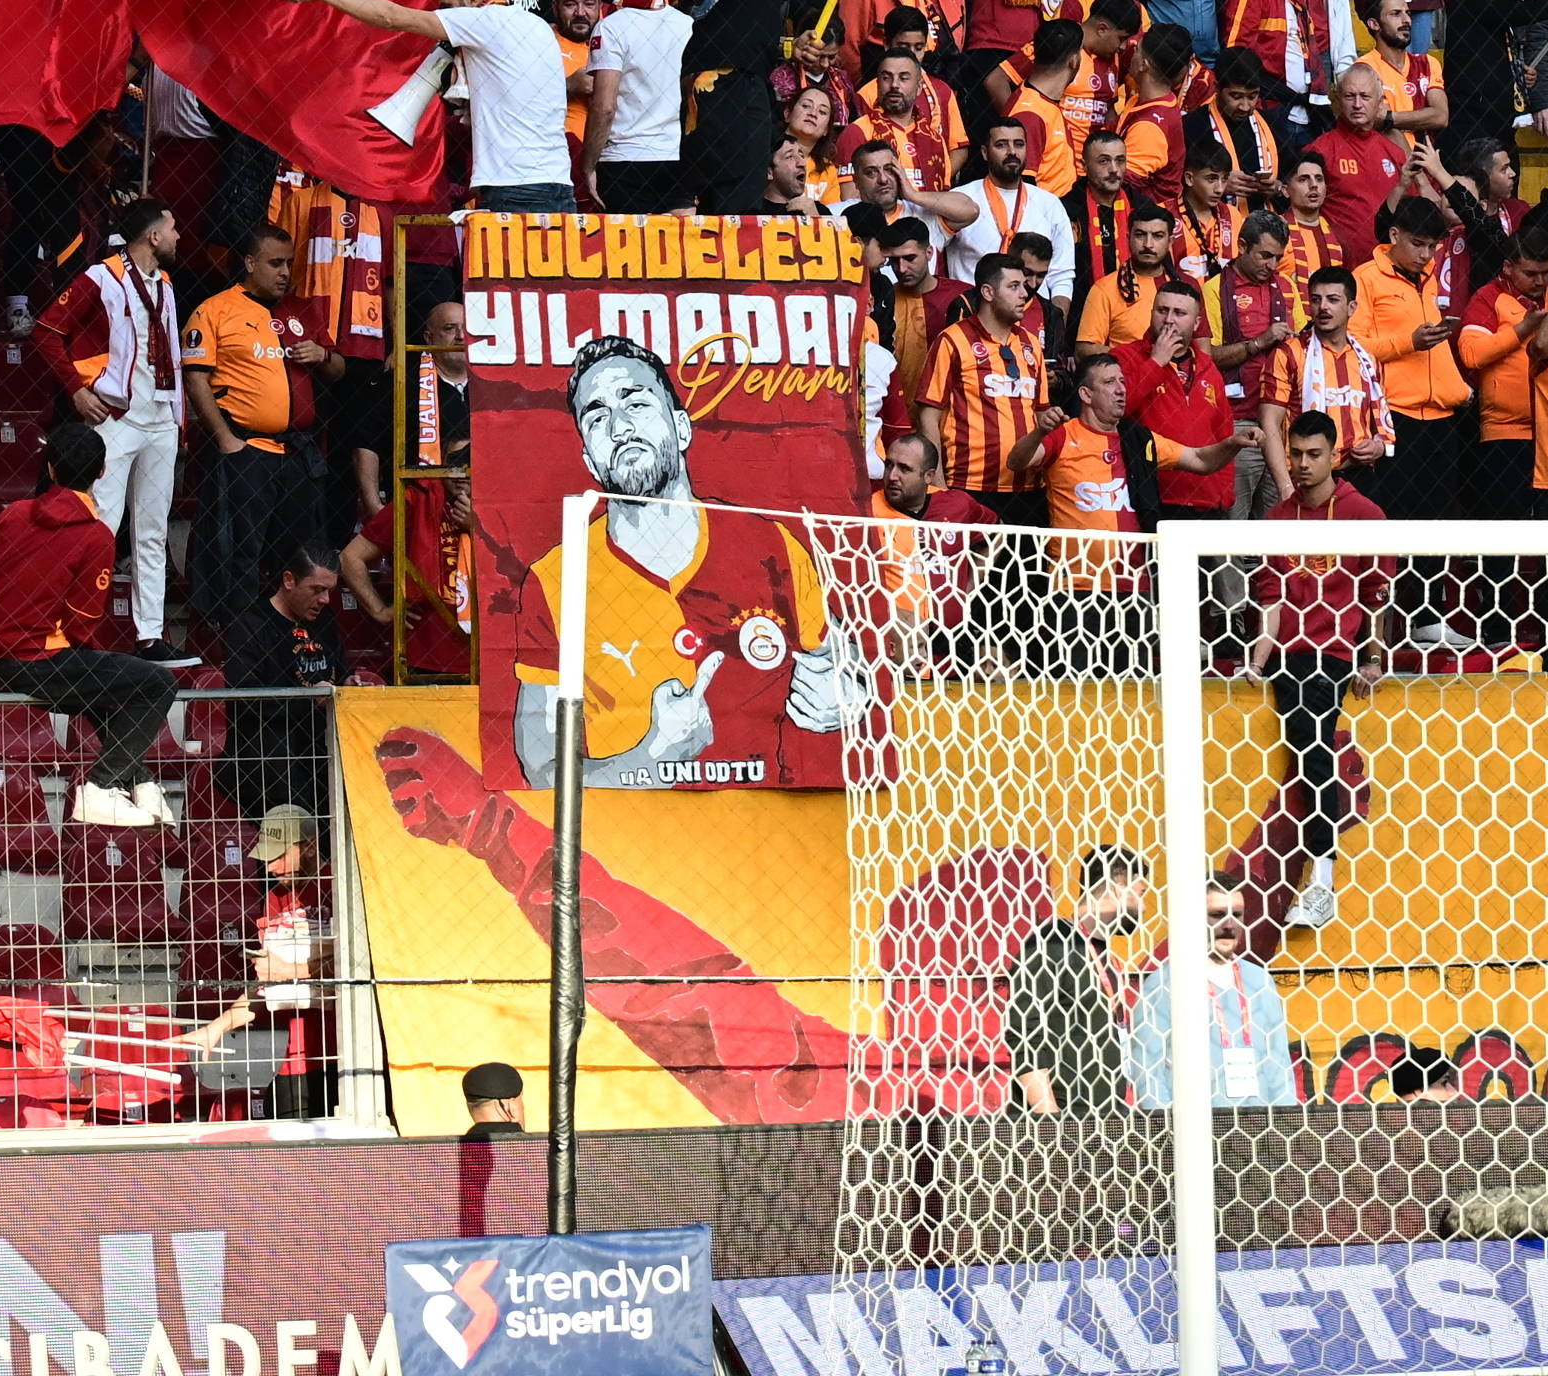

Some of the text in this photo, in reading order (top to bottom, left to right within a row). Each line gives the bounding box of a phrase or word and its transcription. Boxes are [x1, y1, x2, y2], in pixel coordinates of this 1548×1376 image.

[1339, 159, 1359, 174] 09
[676, 332, 854, 421] Devam!
[505, 1255, 691, 1309] trendyol
